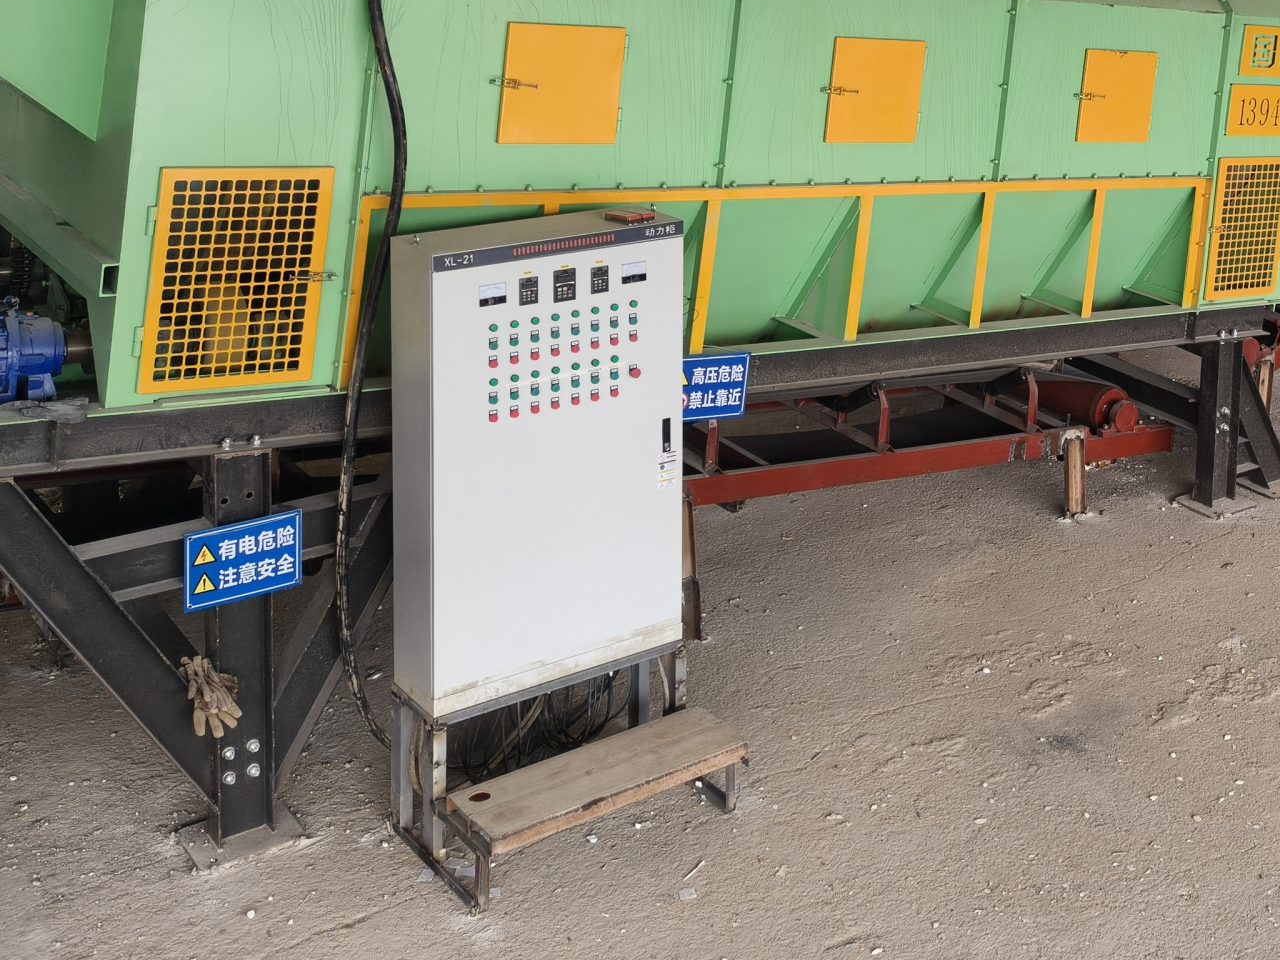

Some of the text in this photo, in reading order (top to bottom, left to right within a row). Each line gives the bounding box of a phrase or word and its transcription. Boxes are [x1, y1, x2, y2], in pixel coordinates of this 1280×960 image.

[645, 224, 676, 237] 动力柜
[444, 254, 474, 267] XL-21
[691, 364, 744, 386] 高压危险
[688, 388, 741, 410] 禁止靠近
[218, 525, 295, 562] 有电危险
[218, 553, 295, 590] 注意安全
